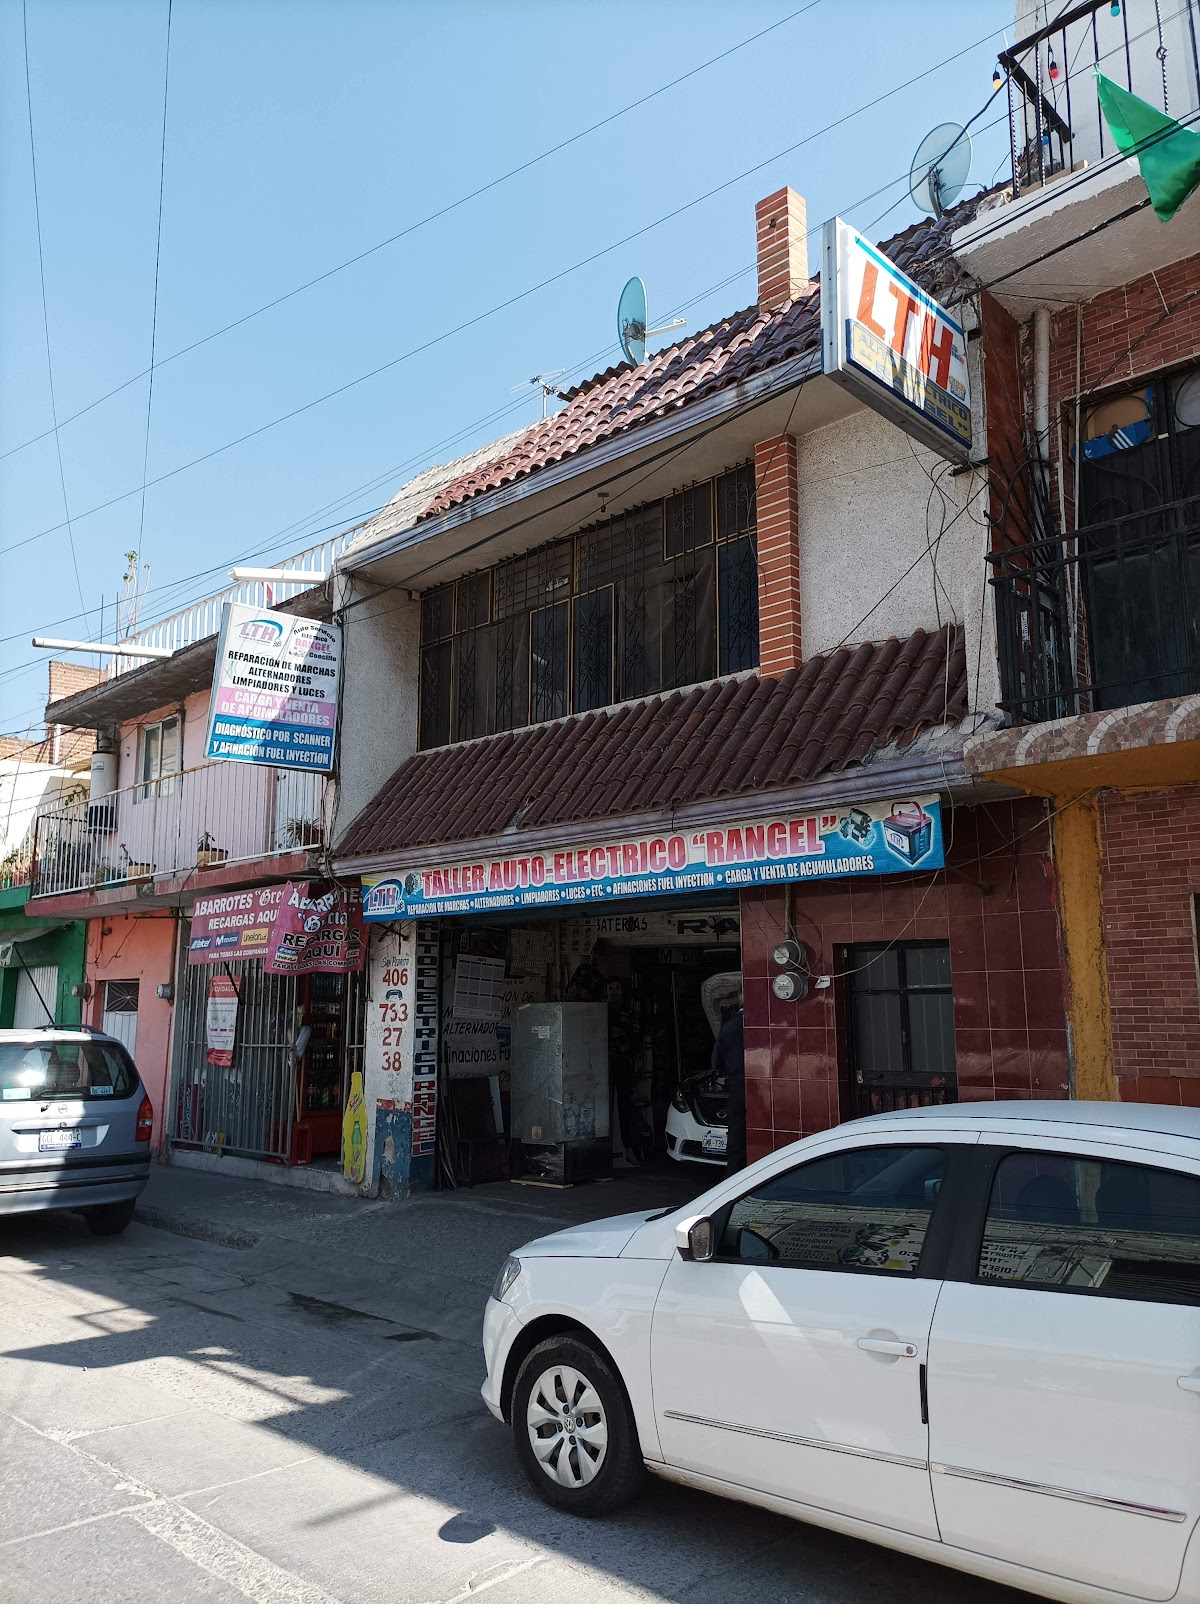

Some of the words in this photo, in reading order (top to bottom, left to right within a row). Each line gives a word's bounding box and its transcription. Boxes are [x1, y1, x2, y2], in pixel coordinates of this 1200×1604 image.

[857, 260, 953, 391] LTH
[240, 622, 277, 642] LTH
[295, 638, 331, 652] RANGEL
[228, 650, 280, 669] REPARACIÓN
[281, 661, 292, 670] DE
[294, 663, 336, 677] MARCHAS
[248, 667, 312, 685] ALTERNADORES
[232, 676, 290, 693] LIMPIADORES
[291, 686, 298, 694] Y
[298, 687, 325, 698] LUCES
[235, 691, 273, 707] CARGA
[274, 697, 281, 708] Y
[284, 699, 319, 713] VENTA
[220, 701, 236, 714] DE
[237, 703, 330, 726] ACUMULADORES
[215, 722, 271, 740] DIAGNÓSTICO
[273, 730, 290, 743] POR
[293, 732, 331, 747] SCANNER
[213, 741, 220, 752] Y
[219, 741, 265, 757] AFINACIÓN
[266, 746, 285, 760] FUEL
[286, 749, 329, 764] INYECTION
[422, 865, 485, 897] TALLER
[489, 837, 686, 890] AUTO-ELECTRICO
[693, 815, 836, 864] “RANGEL”
[407, 903, 436, 915] REPARACION
[436, 903, 444, 913] DE
[444, 899, 469, 912] MARCHAS
[475, 895, 514, 909] ALTERNADORES
[521, 889, 560, 904] LIMPIADORES
[566, 887, 585, 899] LUCES
[592, 884, 605, 897] ETC.
[613, 879, 656, 895] AFINACIONES
[658, 877, 675, 890] FUEL
[675, 872, 714, 888] INYECTION
[725, 869, 752, 883] CARGA
[753, 869, 759, 880] Y
[760, 865, 786, 879] VENTA
[787, 865, 799, 877] DE
[800, 855, 874, 875] ACUMULADORES
[194, 893, 253, 917] ABARROTES
[369, 887, 397, 907] LTH
[208, 912, 255, 930] RECARGAS
[220, 950, 233, 958] TODAS
[302, 942, 341, 961] AQUÍ
[272, 962, 291, 970] PARA
[382, 968, 408, 987] 406
[382, 1027, 403, 1046] 27
[382, 1051, 402, 1072] 38
